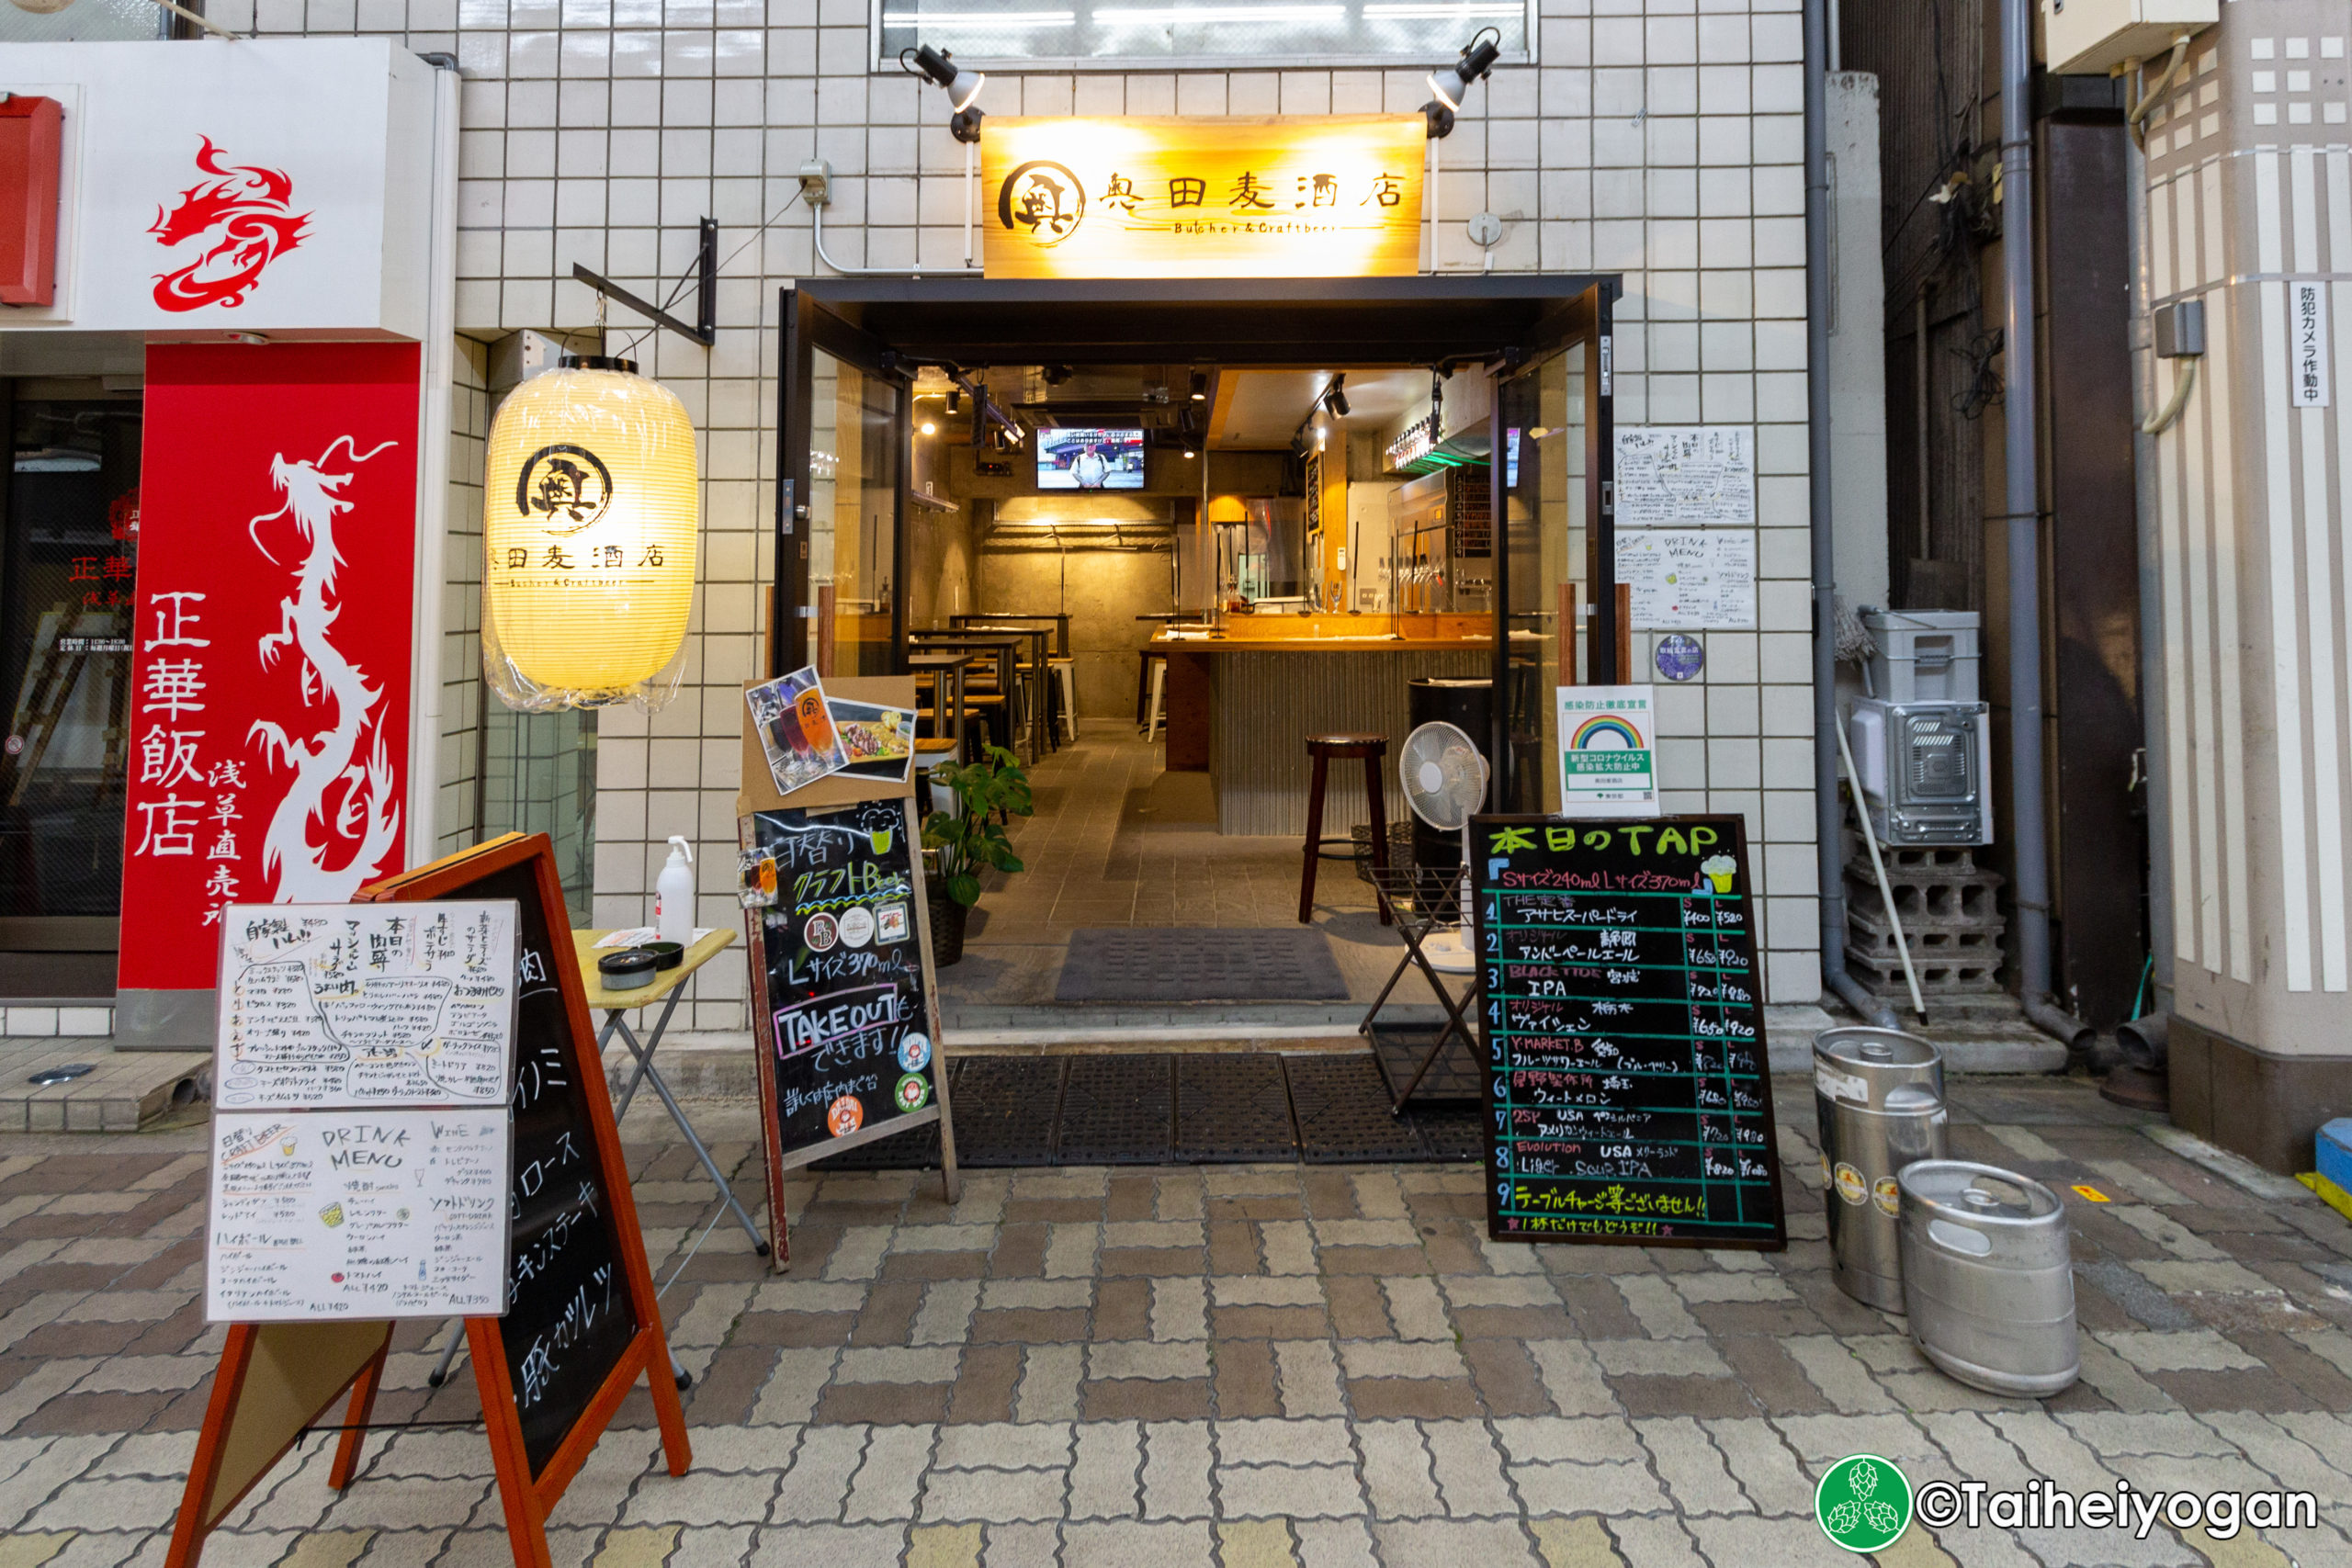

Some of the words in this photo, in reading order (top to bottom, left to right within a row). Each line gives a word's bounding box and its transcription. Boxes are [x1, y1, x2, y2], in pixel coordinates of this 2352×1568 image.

[1100, 172, 1406, 209] 奥田麦酒店
[1174, 222, 1238, 234] Butcher
[1259, 222, 1336, 234] Craftbeer
[2301, 287, 2318, 402] 防犯カメラ作動中
[1565, 699, 1646, 710] 感染防止徹底宣言
[134, 591, 210, 857] 正華飯店
[1570, 753, 1645, 763] 新型コロナウイルス
[1577, 762, 1640, 772] 感染拡大防止中
[1488, 826, 1718, 856] 本日のTAP
[1683, 897, 1692, 908] S
[1715, 899, 1723, 908] L
[1517, 906, 1638, 923] アサヒスーパードライ
[1715, 909, 1743, 926] ¥520
[386, 917, 407, 958] 本日の
[1487, 935, 1498, 952] 2
[1686, 933, 1694, 942] S
[1719, 933, 1729, 942] L
[1519, 944, 1640, 962] アンバーペールエール
[1487, 968, 1498, 988] 3
[1509, 964, 1559, 978] BLACK
[1690, 971, 1698, 980] S
[1722, 972, 1731, 980] L
[1527, 979, 1566, 997] IPA
[1487, 1000, 1500, 1024] 4
[1692, 1005, 1702, 1016] S
[1492, 1038, 1504, 1060] 5
[1695, 1041, 1704, 1051] S
[1726, 1041, 1735, 1049] L
[1493, 1076, 1507, 1098] 6
[1697, 1077, 1707, 1088] S
[1495, 1111, 1507, 1130] 7
[1557, 1110, 1584, 1122] USA
[1701, 1114, 1710, 1125] S
[1734, 1115, 1742, 1123] L
[322, 1124, 412, 1147] DRINK
[331, 1150, 402, 1171] MENU
[1496, 1146, 1510, 1168] 8
[1600, 1145, 1632, 1158] USA
[1704, 1147, 1713, 1157] S
[1618, 1159, 1652, 1178] IPA
[1497, 1183, 1510, 1205] 9
[429, 1195, 495, 1212] ソフトドリンク
